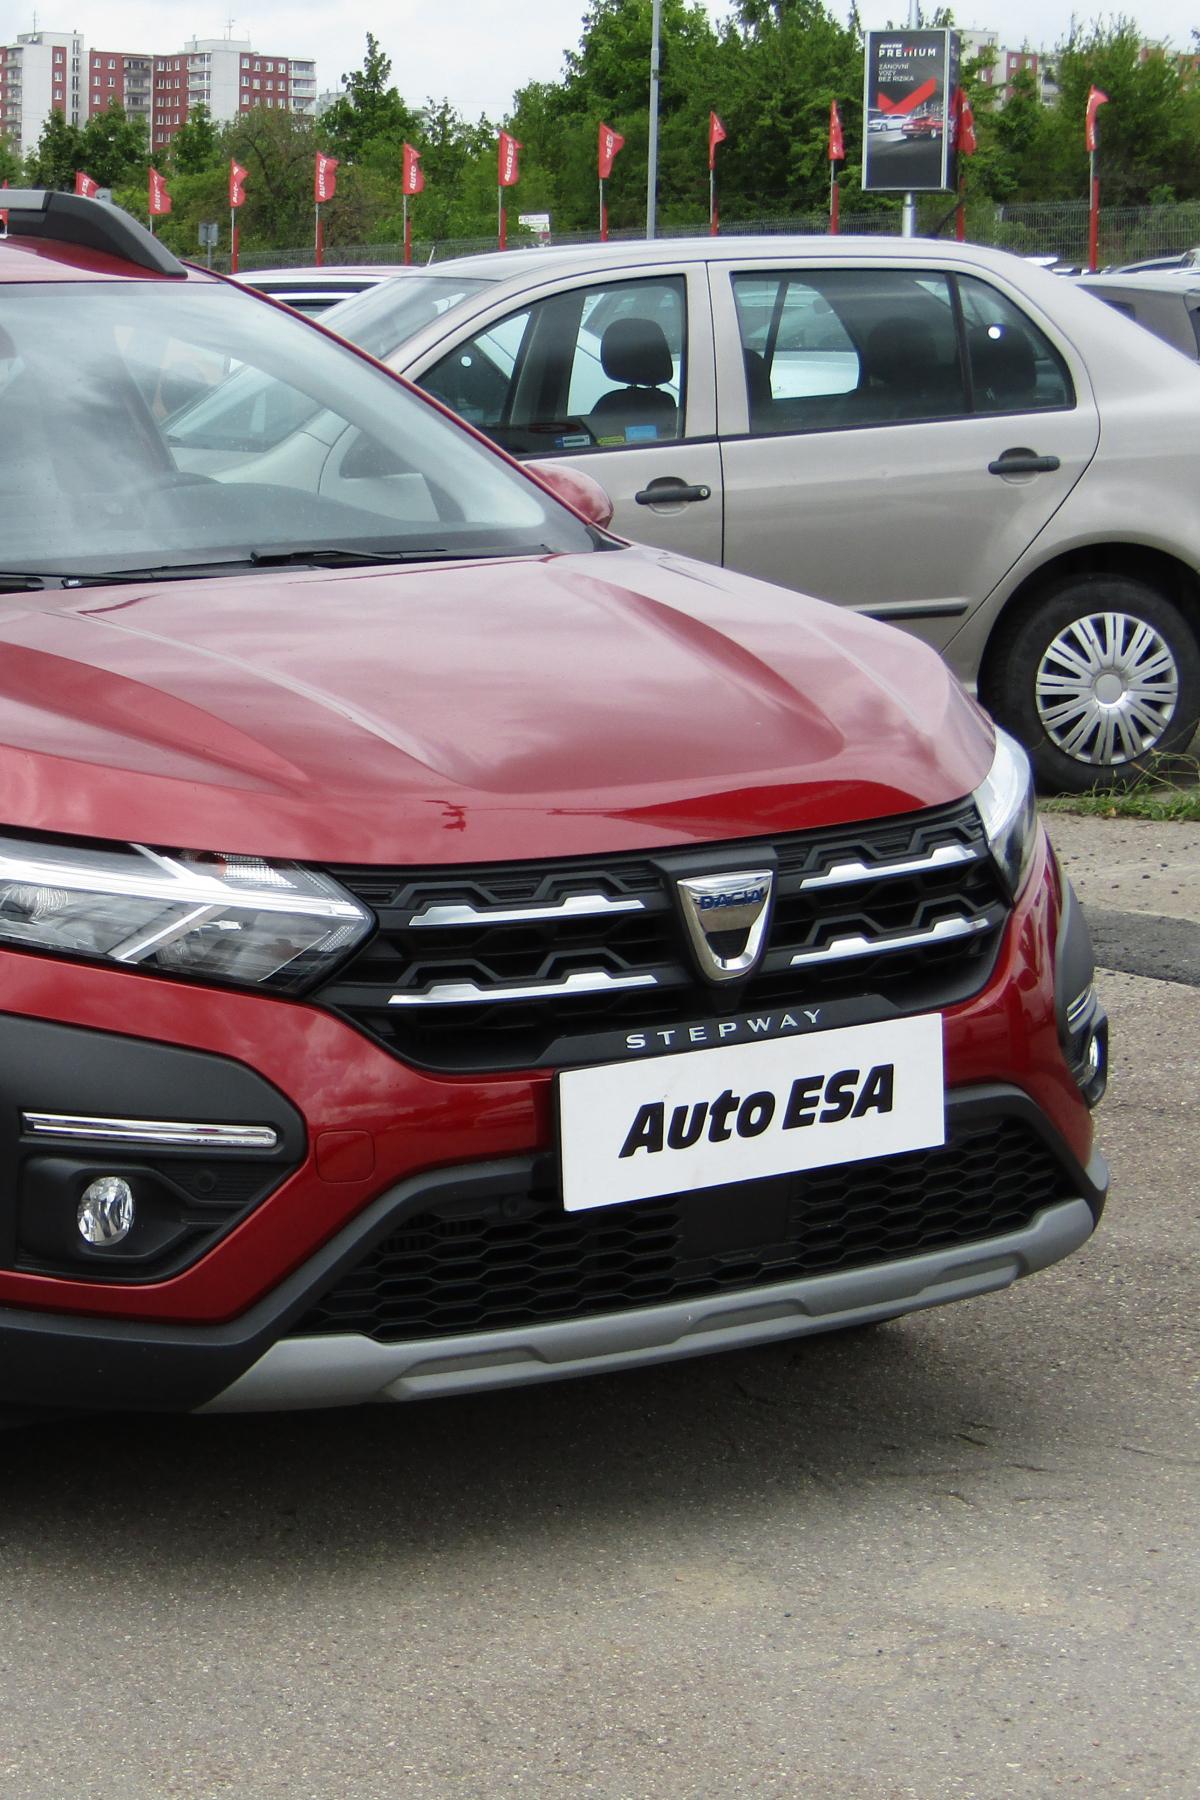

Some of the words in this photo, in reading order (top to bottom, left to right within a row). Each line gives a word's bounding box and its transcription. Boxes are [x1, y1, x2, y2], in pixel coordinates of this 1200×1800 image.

[879, 47, 936, 58] PREMIUM
[409, 165, 417, 190] Auto
[504, 156, 513, 182] Auto
[699, 887, 765, 910] DACIA
[626, 1008, 821, 1049] STEPWAY
[618, 1089, 776, 1159] Auto
[782, 1063, 894, 1130] ESA
